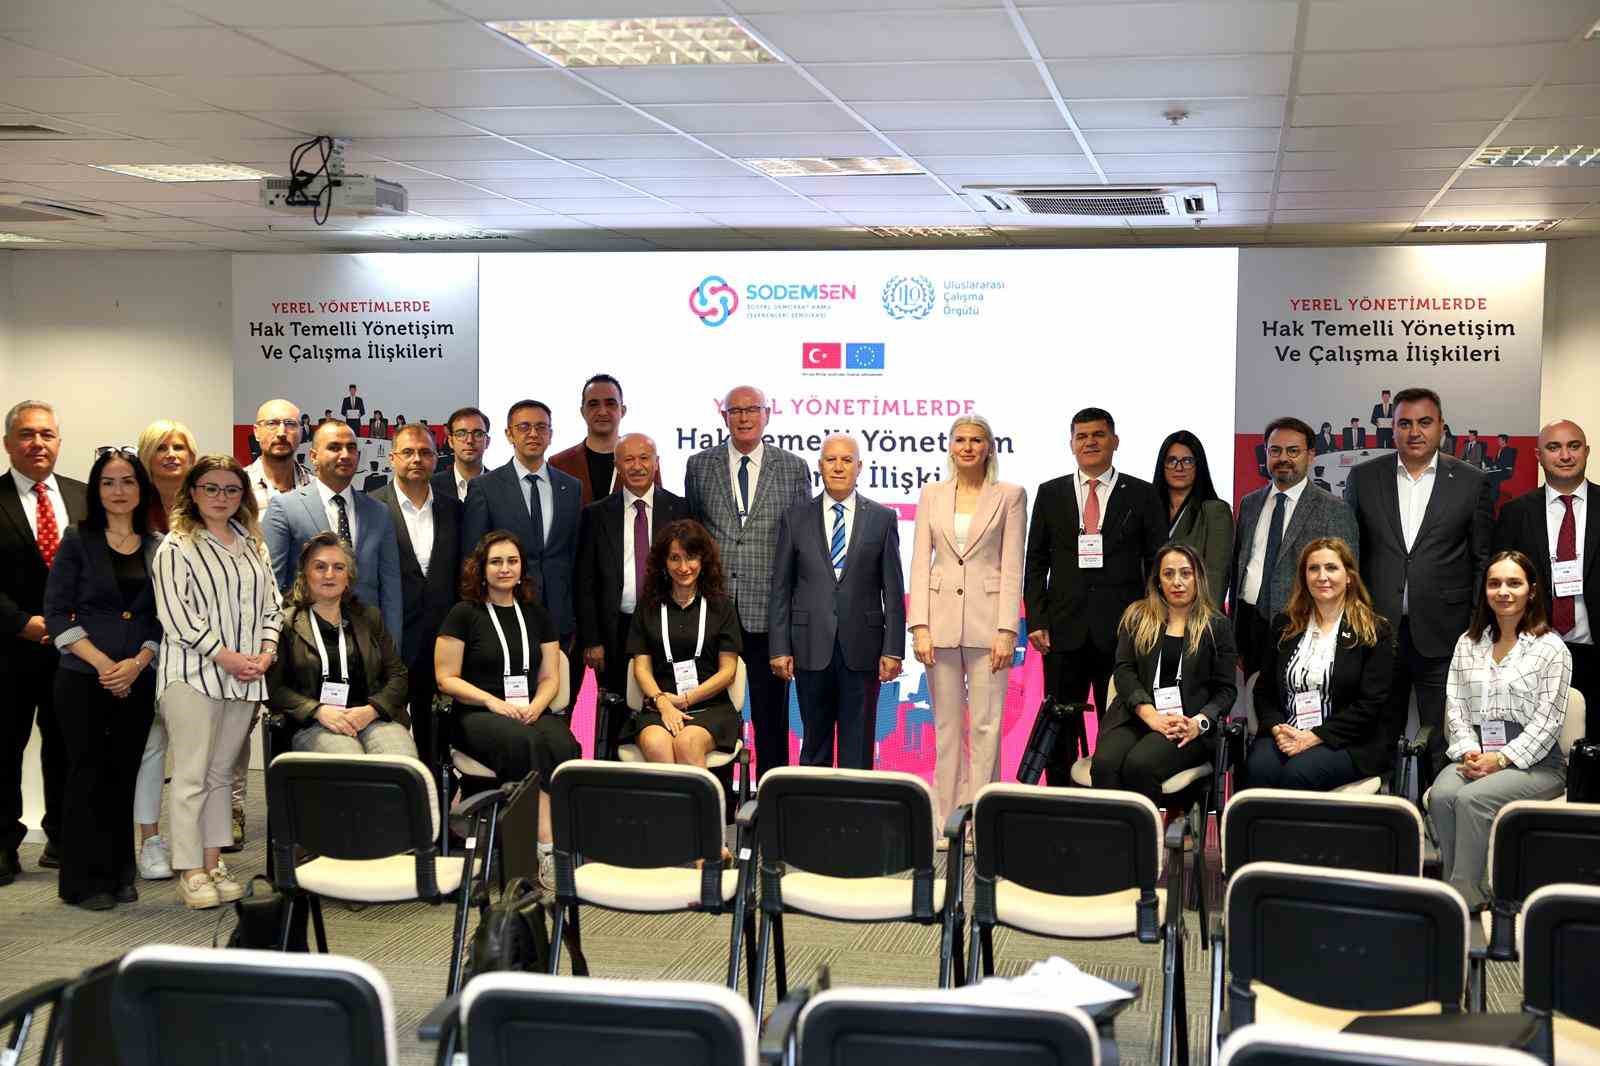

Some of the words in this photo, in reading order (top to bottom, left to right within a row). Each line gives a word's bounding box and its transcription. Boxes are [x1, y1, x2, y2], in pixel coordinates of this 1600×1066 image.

[746, 284, 857, 300] SODEMSEN
[943, 280, 1006, 290] Uluslararası
[272, 302, 315, 313] YEREL
[319, 299, 431, 313] YÖNETİMLERDE
[943, 292, 984, 304] Çalışma
[1290, 299, 1343, 311] YEREL
[1348, 297, 1487, 311] YÖNETİMLERDE
[249, 322, 285, 336] Hak
[290, 321, 357, 337] Temelli
[362, 320, 455, 339] Yönetişim
[1262, 321, 1304, 337] Hak
[1311, 320, 1394, 337] Temelli
[1400, 320, 1515, 340] Yönetişim
[261, 345, 283, 359] Ve
[288, 344, 362, 363] Çalışma
[368, 341, 443, 362] İlişkileri
[1275, 346, 1301, 361] Ve
[1308, 345, 1398, 365] Çalışma
[1406, 342, 1502, 365] İlişkileri
[791, 395, 976, 417] YÖNETİMLERDE
